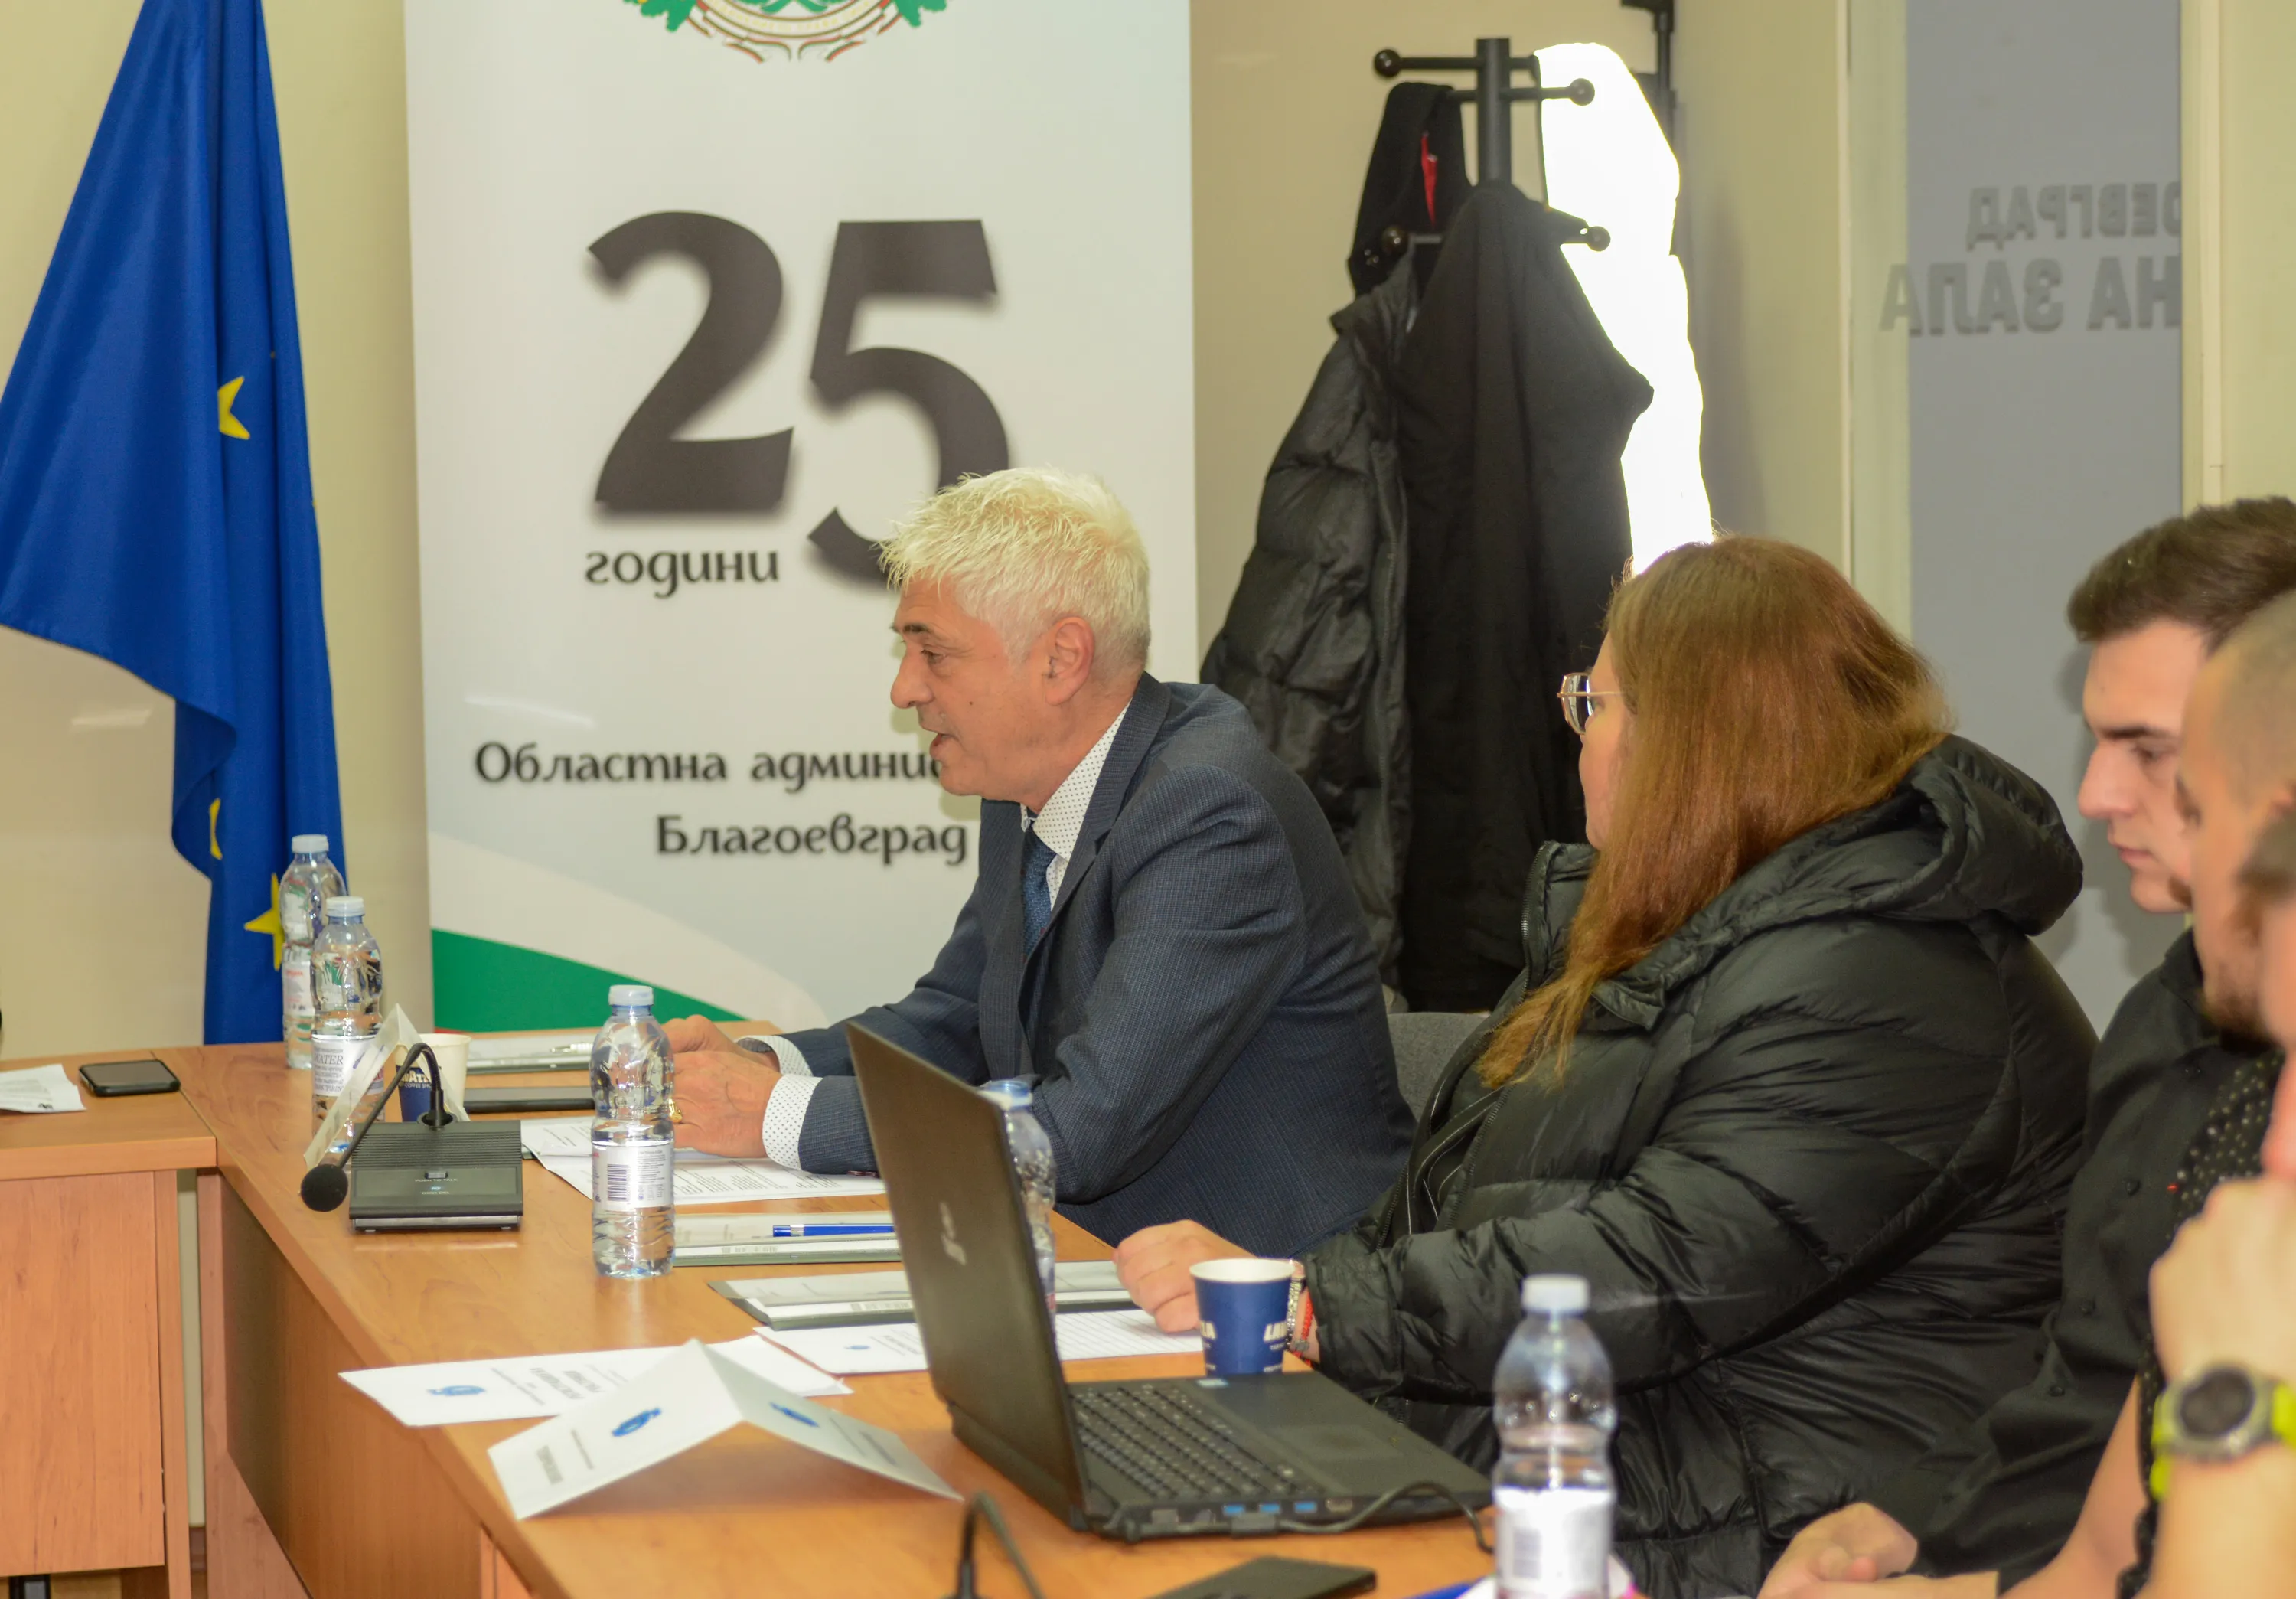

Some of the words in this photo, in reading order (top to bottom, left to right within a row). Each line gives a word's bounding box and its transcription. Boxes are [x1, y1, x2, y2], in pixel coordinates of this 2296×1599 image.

[587, 209, 1009, 591] 25
[584, 549, 780, 599] години
[475, 742, 727, 784] Областна
[654, 813, 968, 866] Благоевград
